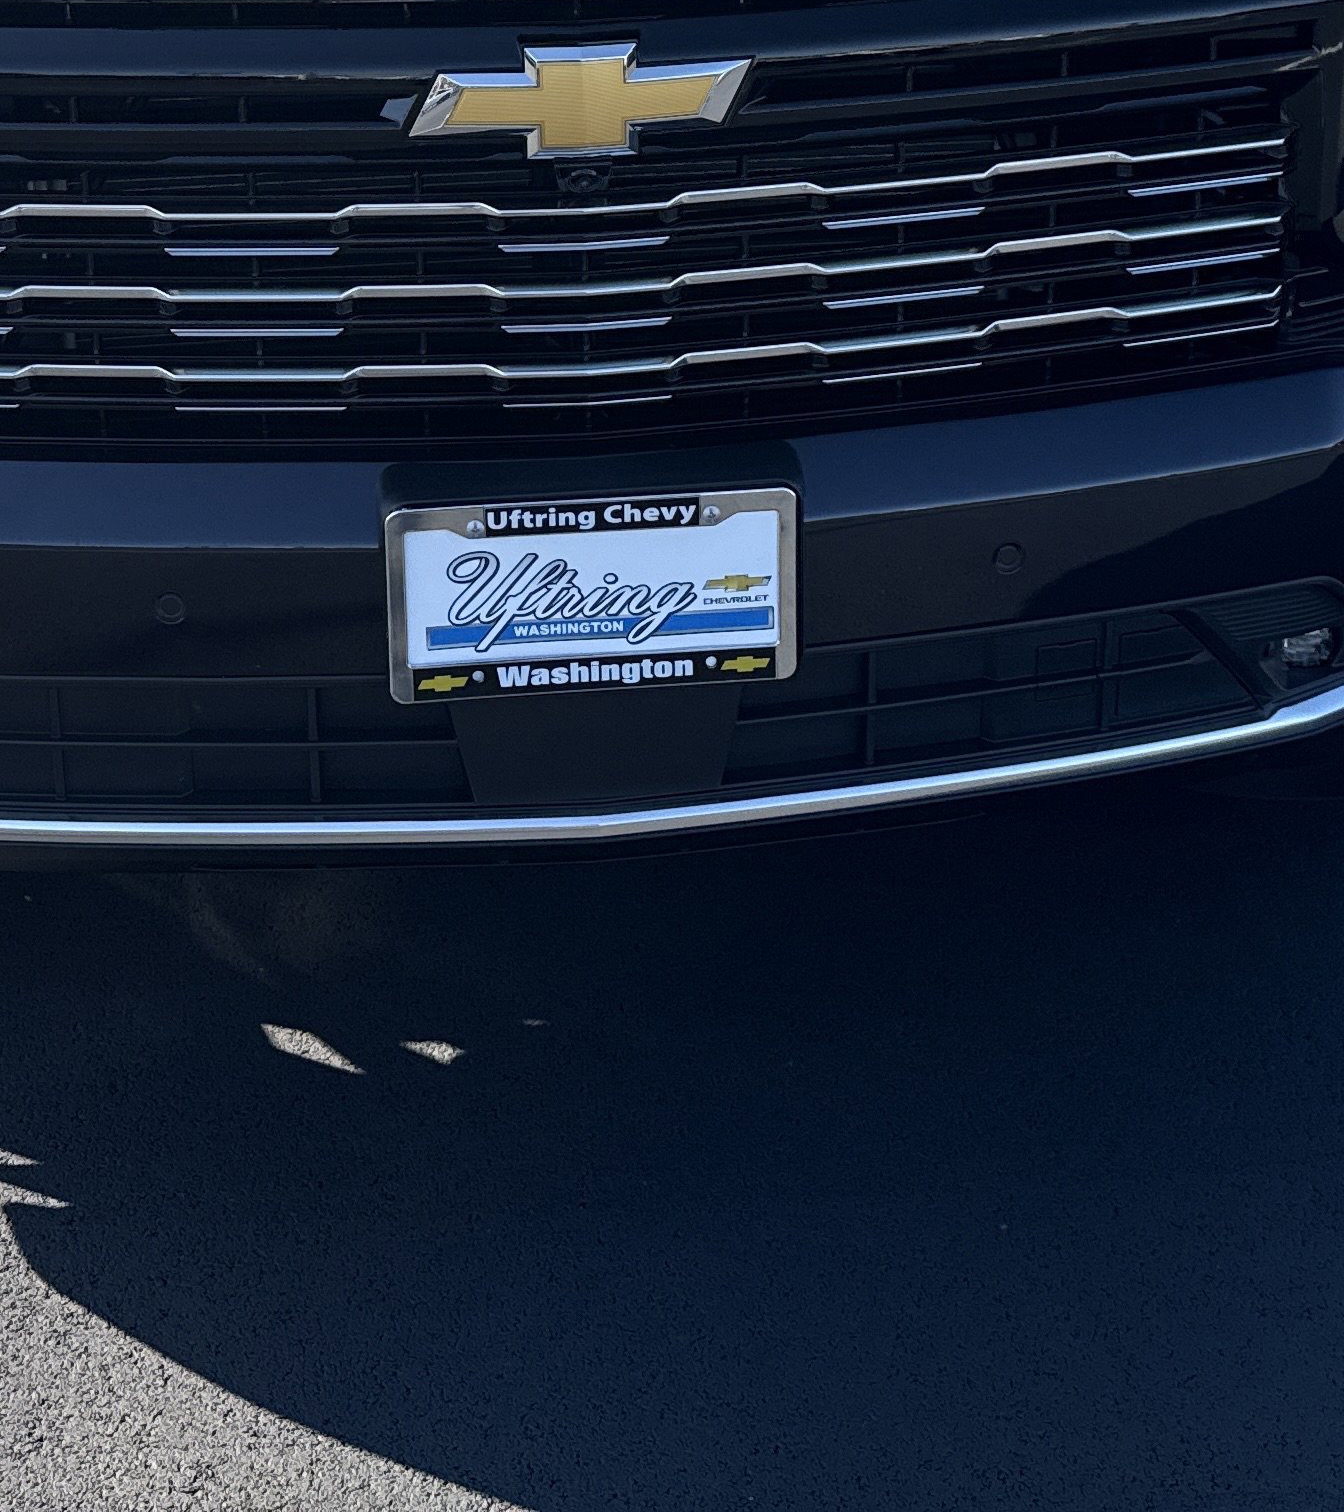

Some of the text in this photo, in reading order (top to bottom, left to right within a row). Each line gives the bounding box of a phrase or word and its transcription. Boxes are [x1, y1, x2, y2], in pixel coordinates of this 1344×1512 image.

[486, 503, 697, 531] Uftring Chevy
[446, 550, 698, 653] Uftring
[702, 593, 770, 606] CHEVROLET
[513, 619, 625, 638] WASHINGTON
[496, 656, 695, 689] Washington
